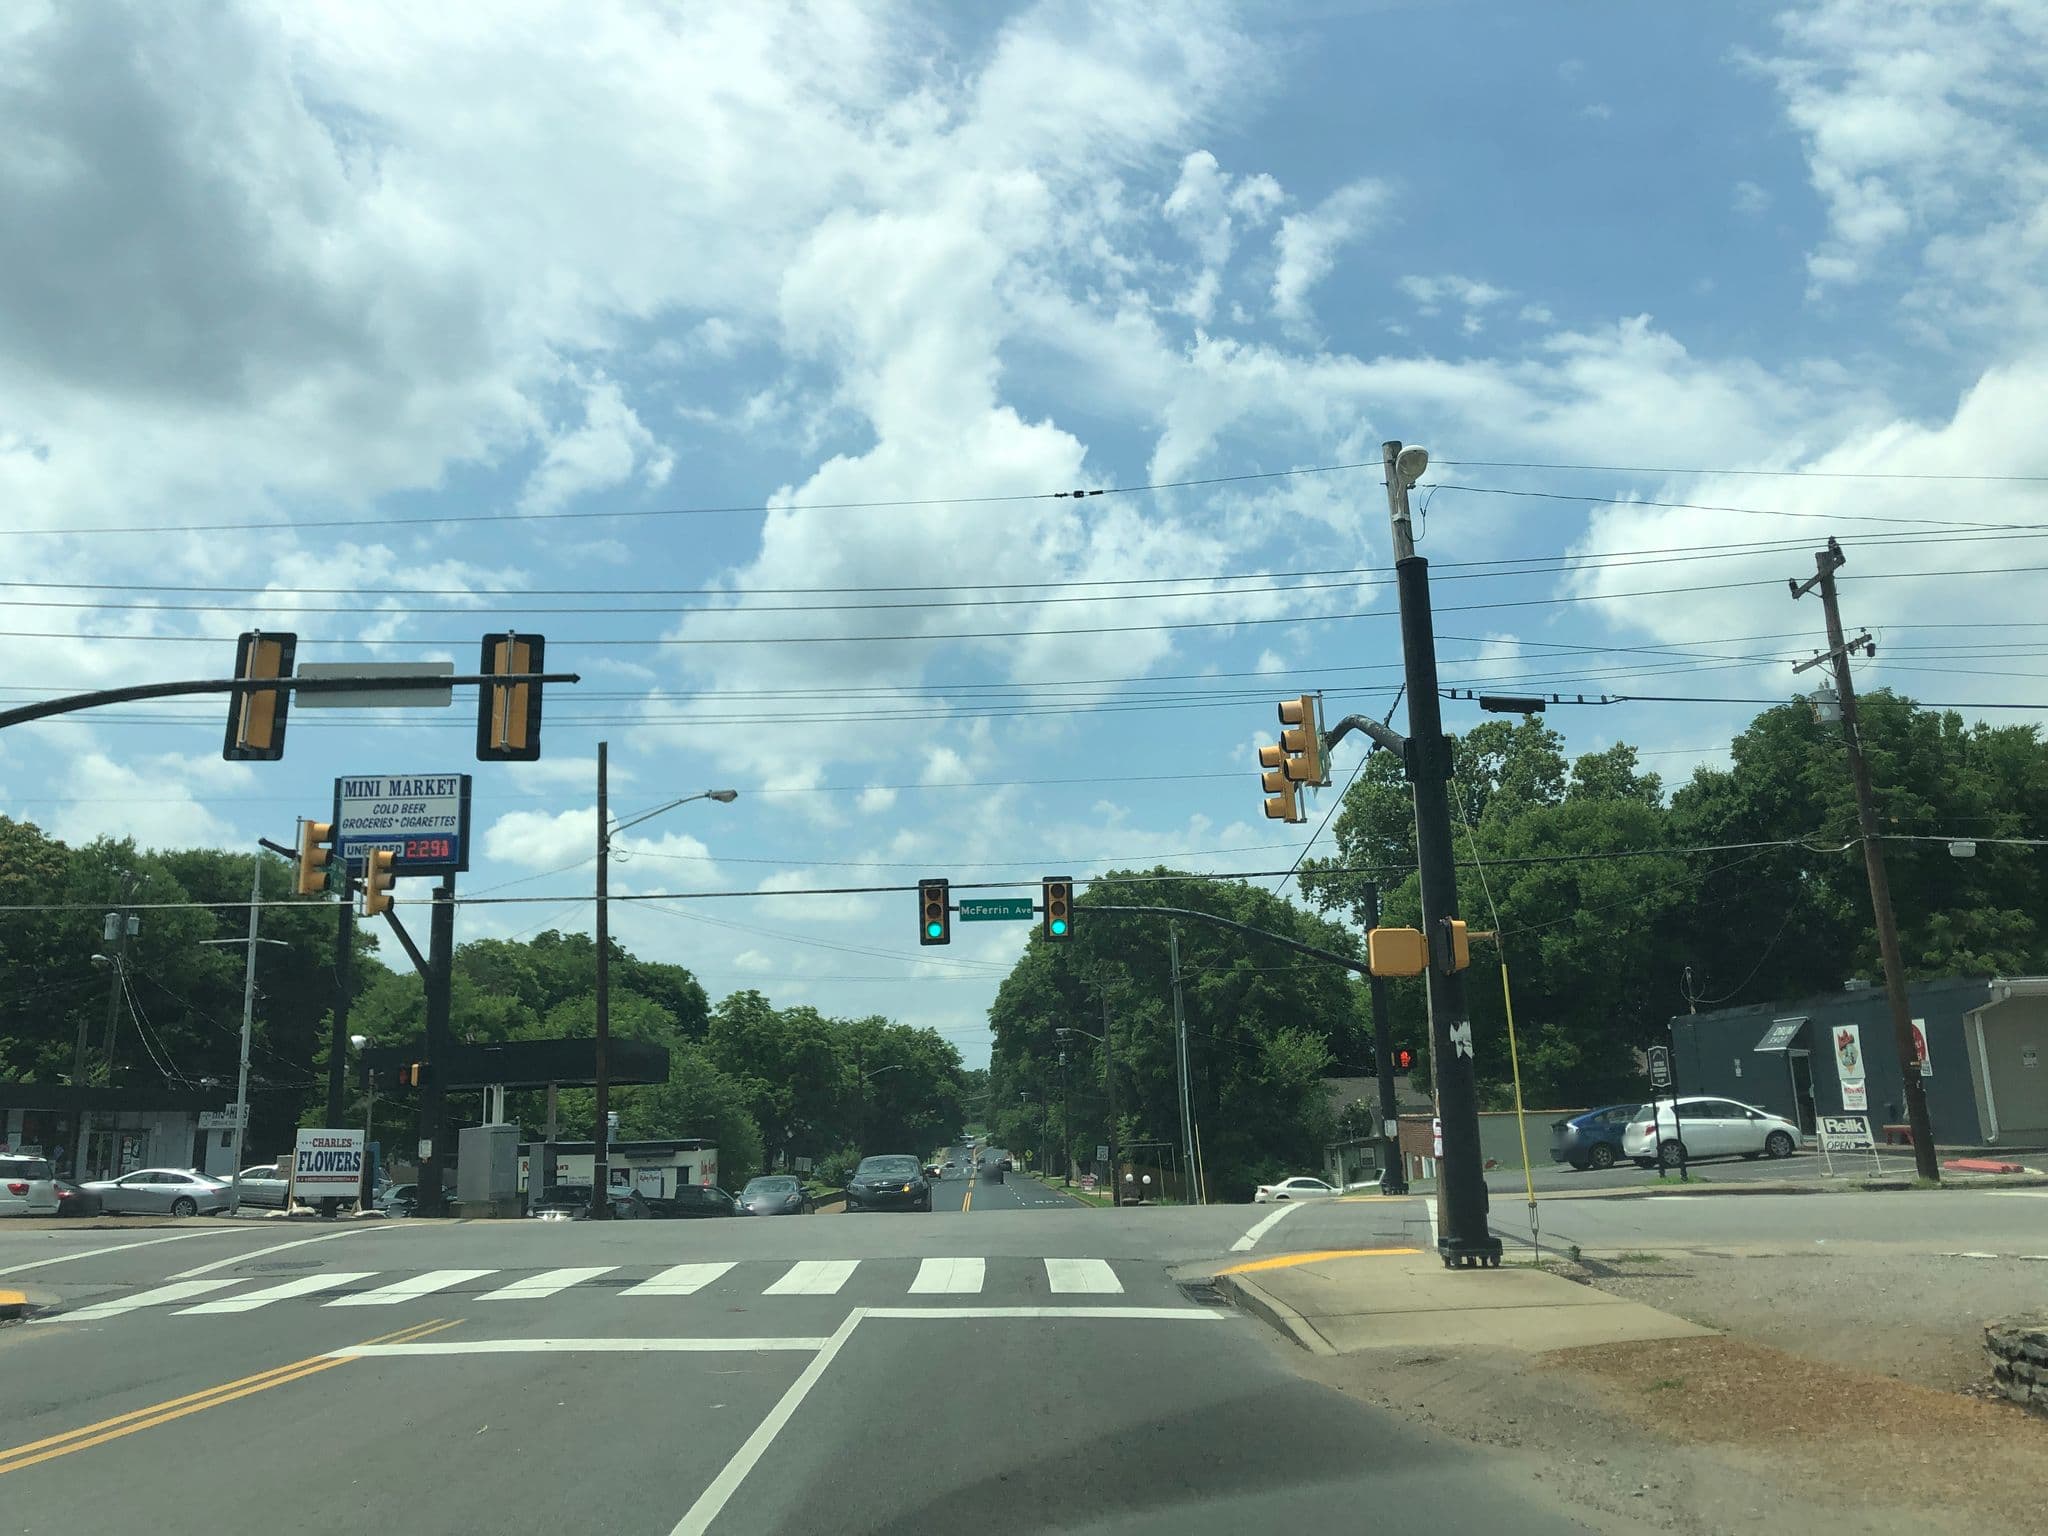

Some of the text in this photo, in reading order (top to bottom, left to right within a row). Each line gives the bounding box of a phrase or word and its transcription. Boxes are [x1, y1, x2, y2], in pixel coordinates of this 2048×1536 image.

[344, 778, 457, 797] MINI MARKET
[373, 803, 426, 815] COLD BEER
[343, 816, 456, 829] GROCERIES CIGARETTES
[961, 905, 1009, 915] McFerrin
[312, 1138, 352, 1148] CHARLES
[1827, 1141, 1853, 1150] OPEN
[298, 1150, 361, 1172] FLOWERS
